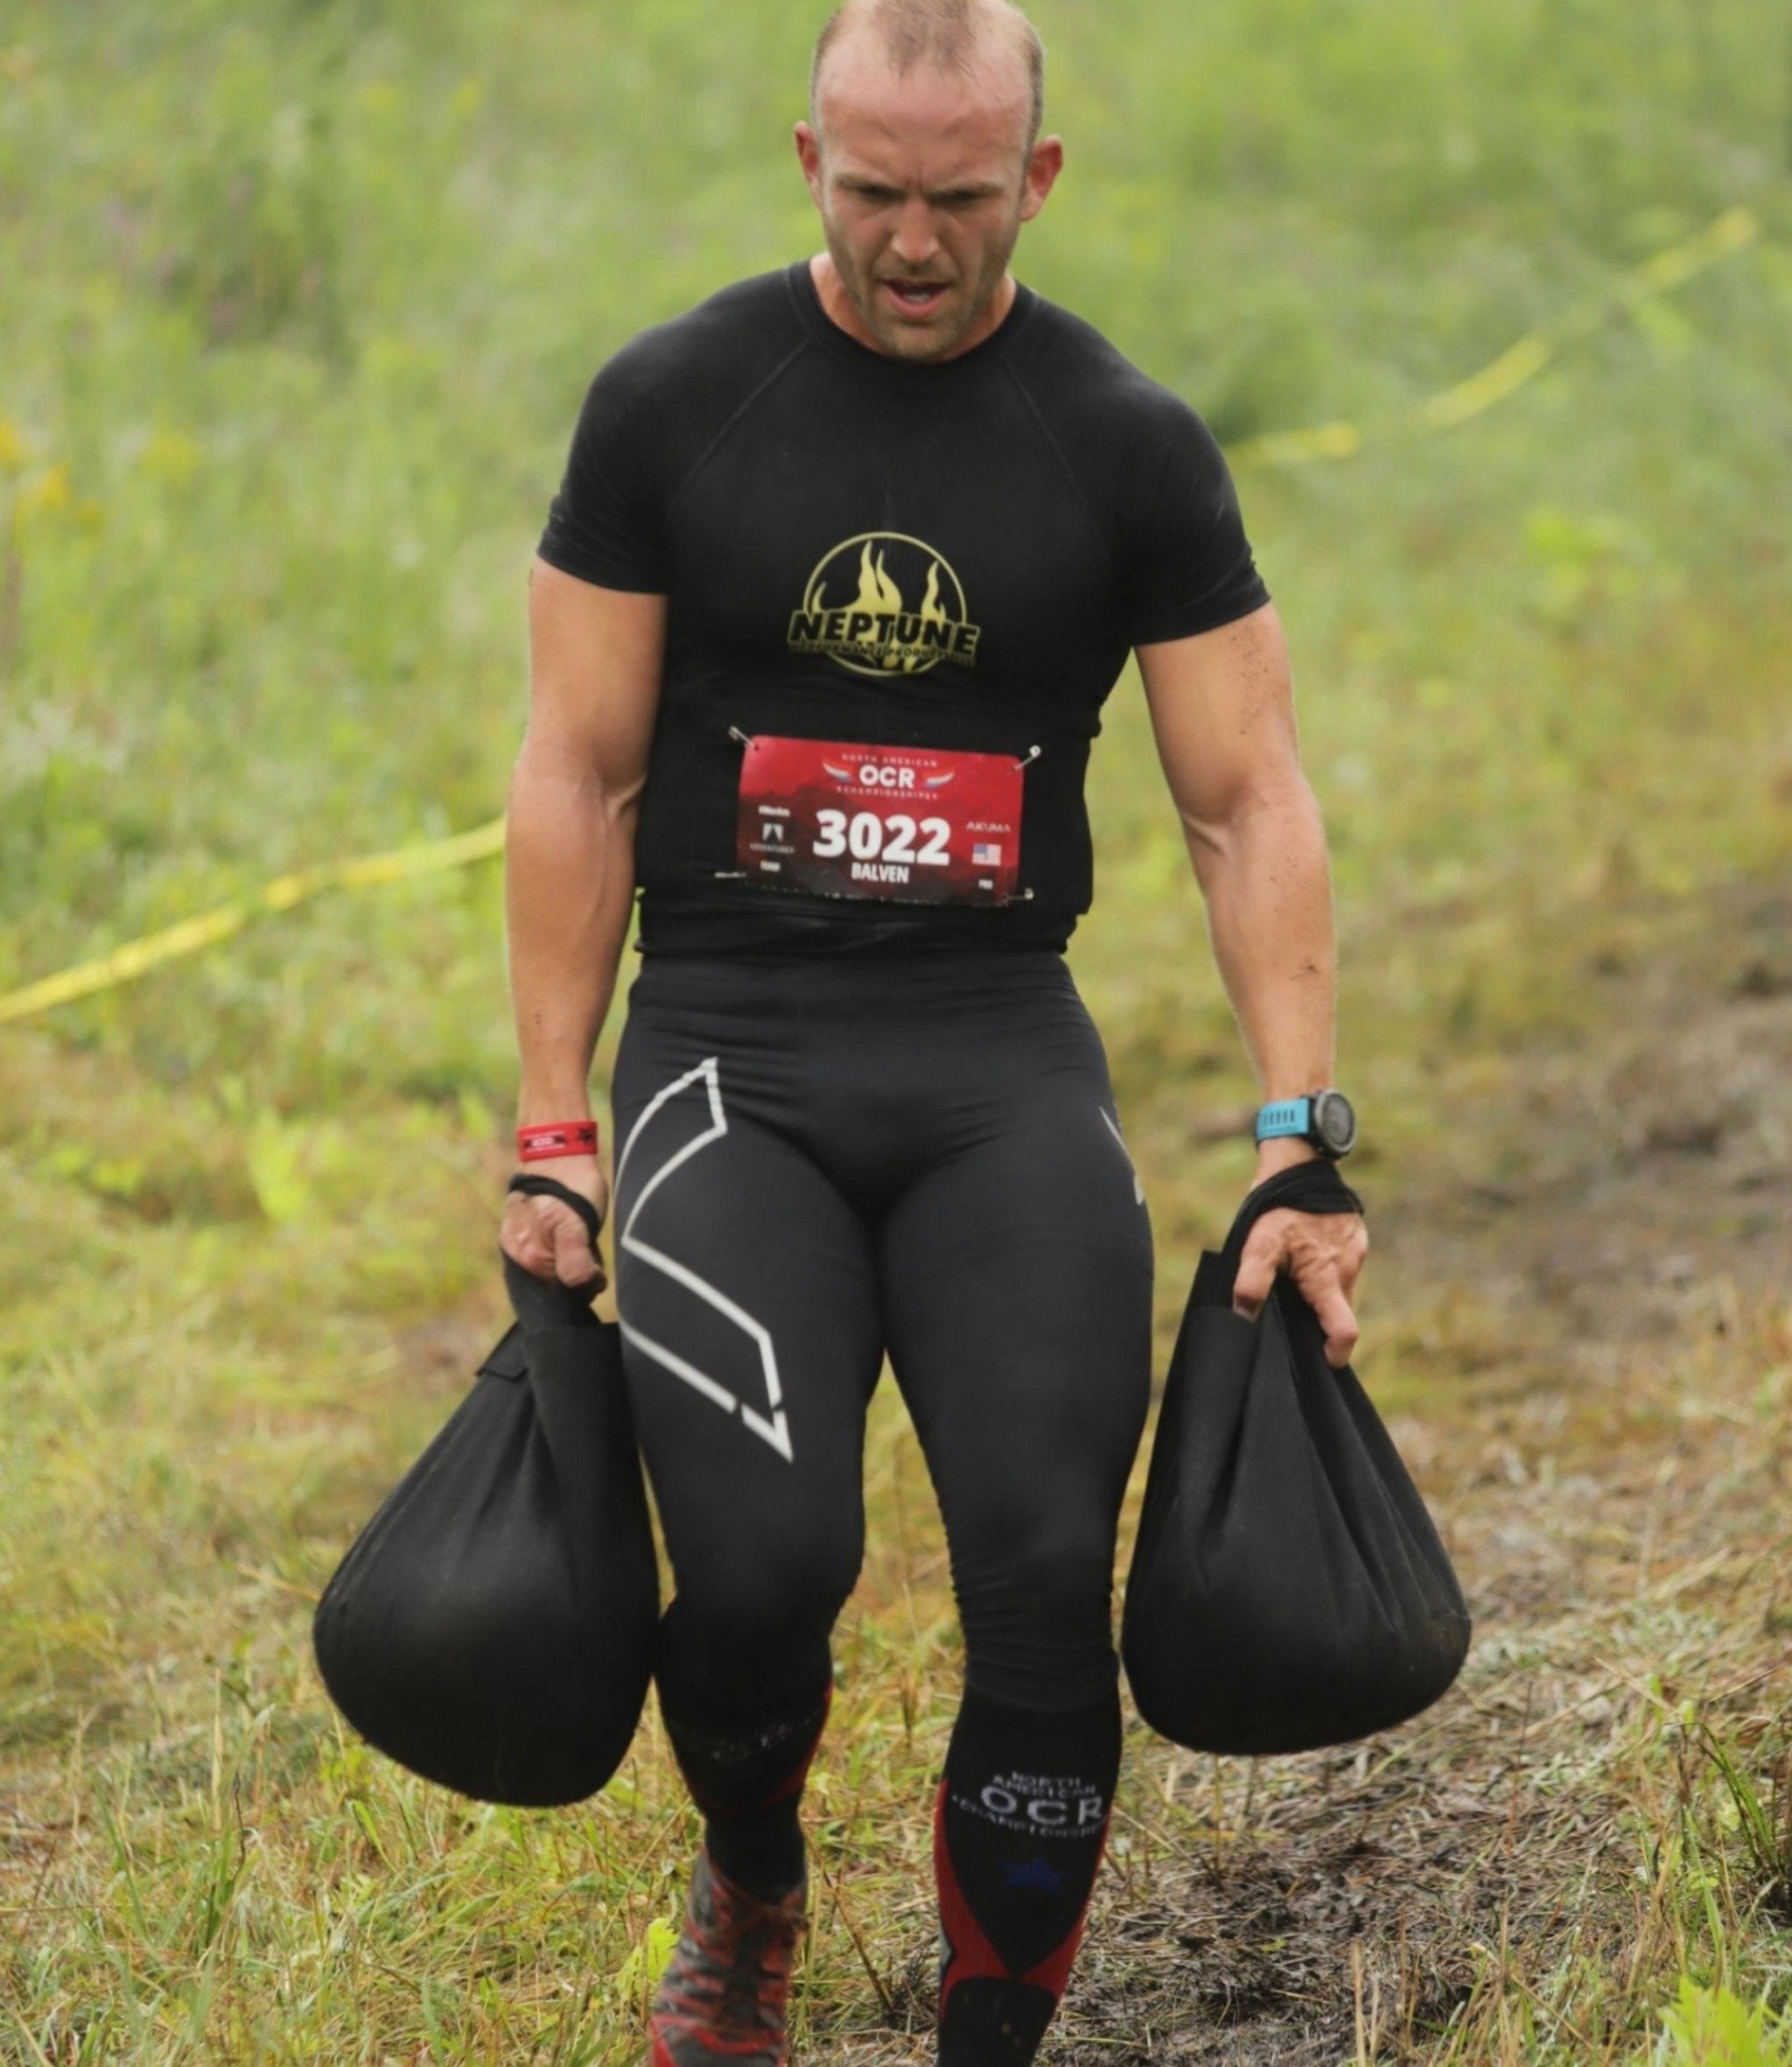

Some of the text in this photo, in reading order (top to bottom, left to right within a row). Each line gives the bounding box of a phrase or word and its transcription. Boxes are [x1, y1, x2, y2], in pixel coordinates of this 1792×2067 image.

[790, 610, 979, 657] NEPTUNE
[859, 763, 915, 789] OCR
[813, 808, 951, 866] 3022
[850, 861, 910, 885] BALVEN
[981, 1784, 1102, 1826] OCR
